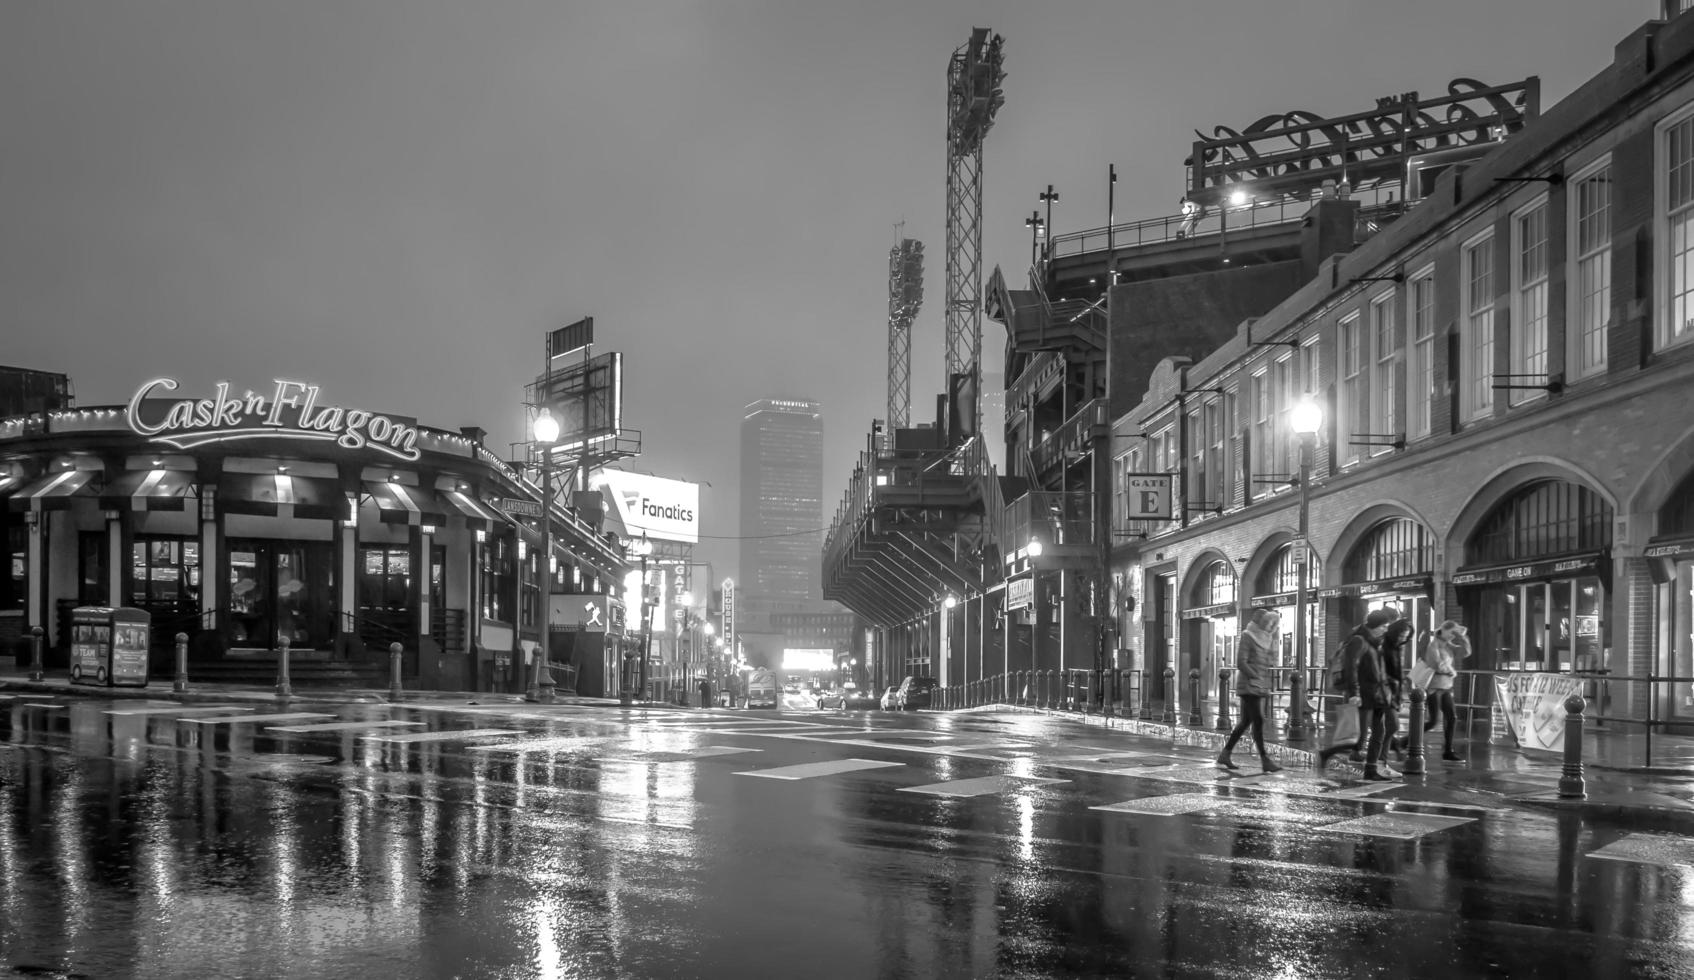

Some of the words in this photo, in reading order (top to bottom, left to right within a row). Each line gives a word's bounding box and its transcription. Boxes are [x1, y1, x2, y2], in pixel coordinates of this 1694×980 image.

[127, 378, 242, 436] Cask
[262, 379, 421, 461] Flagon
[1131, 479, 1168, 488] GATE
[504, 500, 537, 514] LANSDOWNE
[642, 497, 693, 522] Fanatics
[1139, 490, 1159, 514] E
[674, 565, 686, 604] GATE
